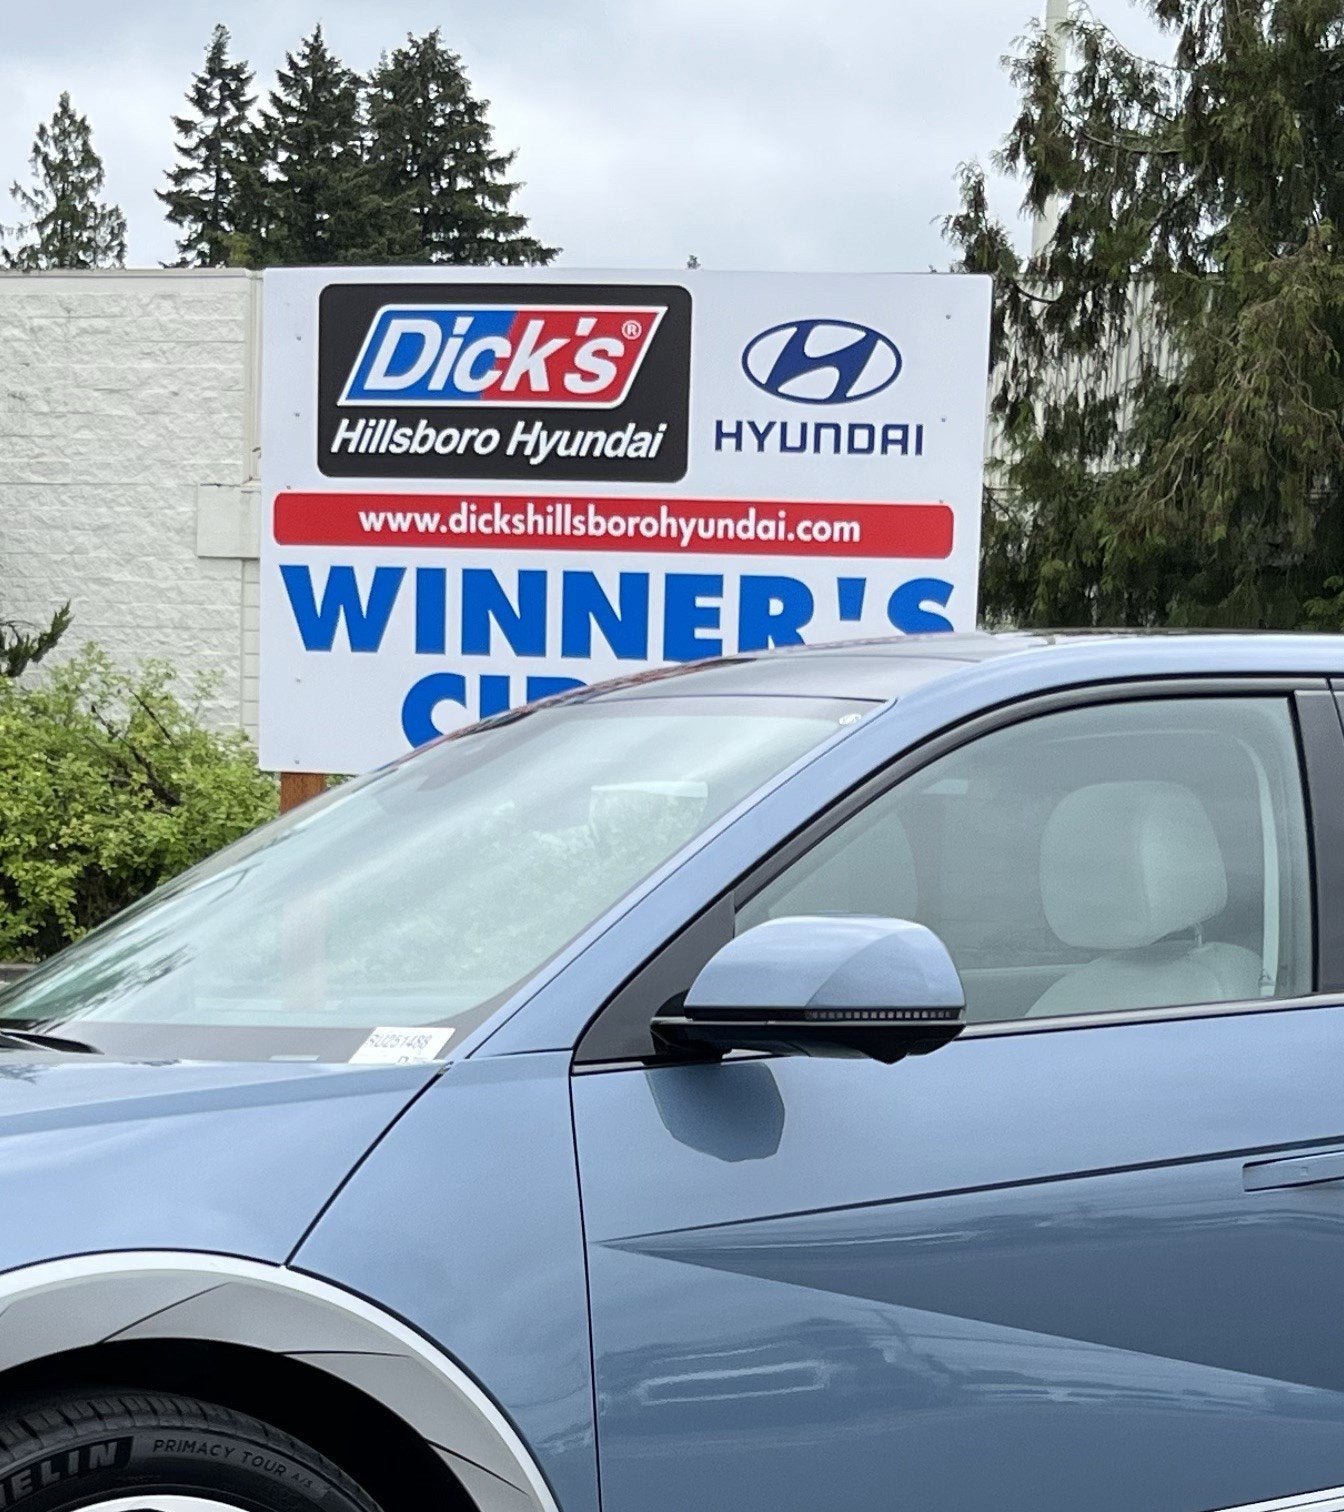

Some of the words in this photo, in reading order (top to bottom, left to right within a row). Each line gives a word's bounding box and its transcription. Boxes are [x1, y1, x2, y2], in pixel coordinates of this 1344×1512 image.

[362, 316, 626, 394] Dick's
[330, 418, 502, 456] Hillsboro
[505, 420, 669, 466] Hyundai
[714, 419, 924, 456] HYUNDAI
[358, 501, 862, 548] www.dickshillsborohyundai.com
[278, 564, 954, 663] WINNER'S
[152, 1438, 233, 1462] PRIMACY
[241, 1451, 288, 1479] TOUR
